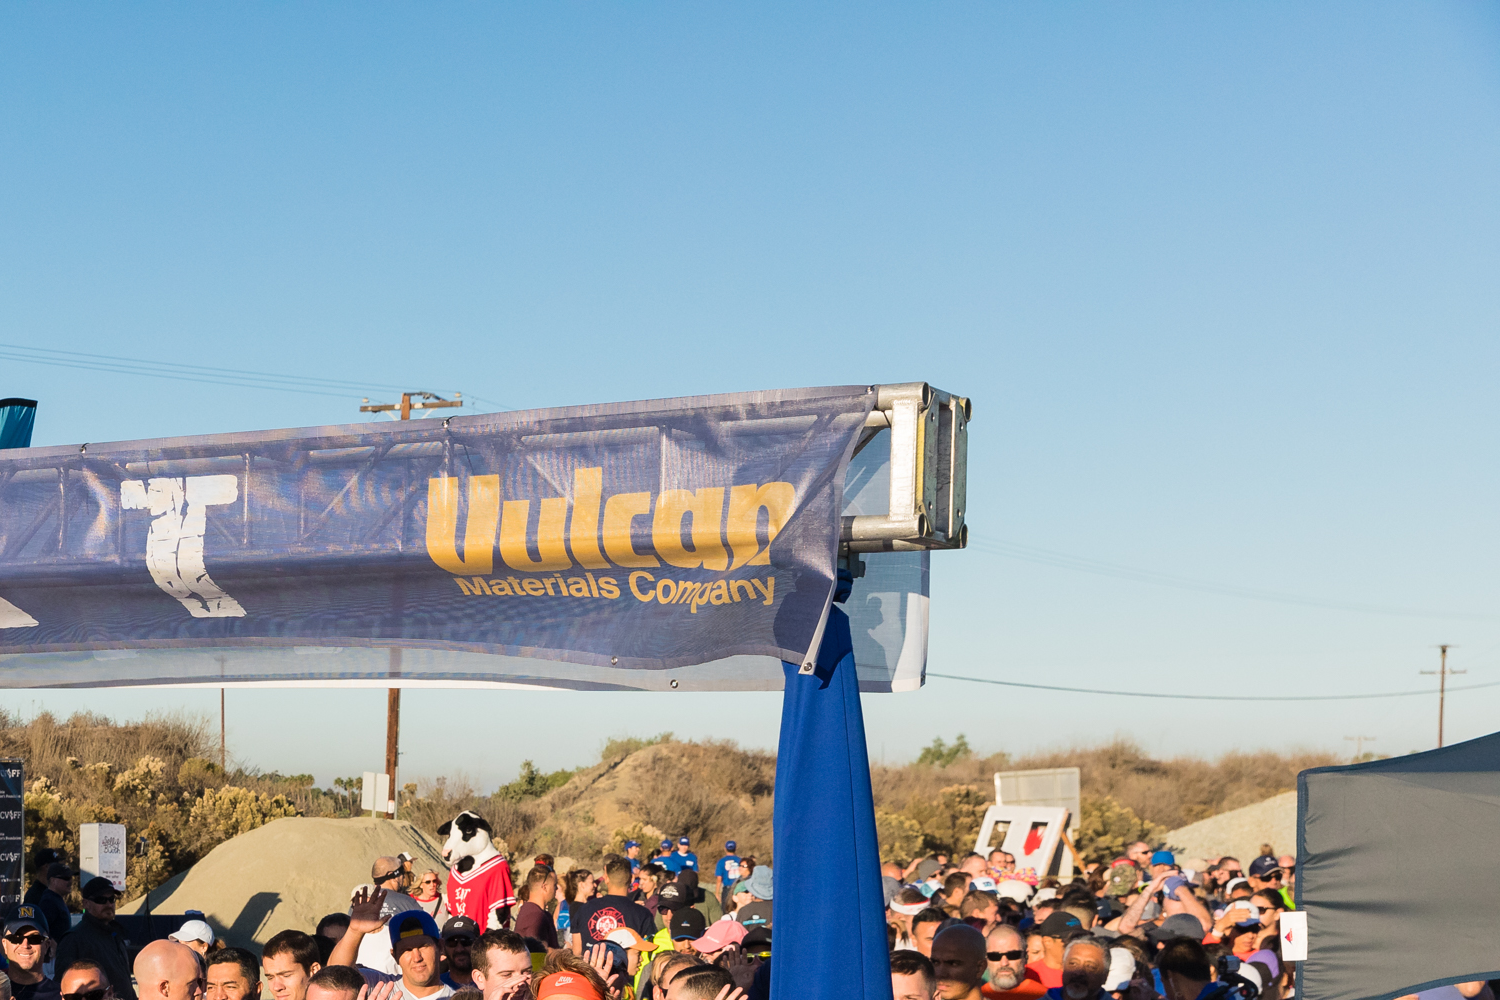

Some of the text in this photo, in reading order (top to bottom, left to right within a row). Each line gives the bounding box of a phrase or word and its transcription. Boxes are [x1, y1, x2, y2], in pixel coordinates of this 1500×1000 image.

[426, 467, 796, 576] Vulcan
[454, 569, 777, 614] Materials Company
[19, 906, 35, 918] N
